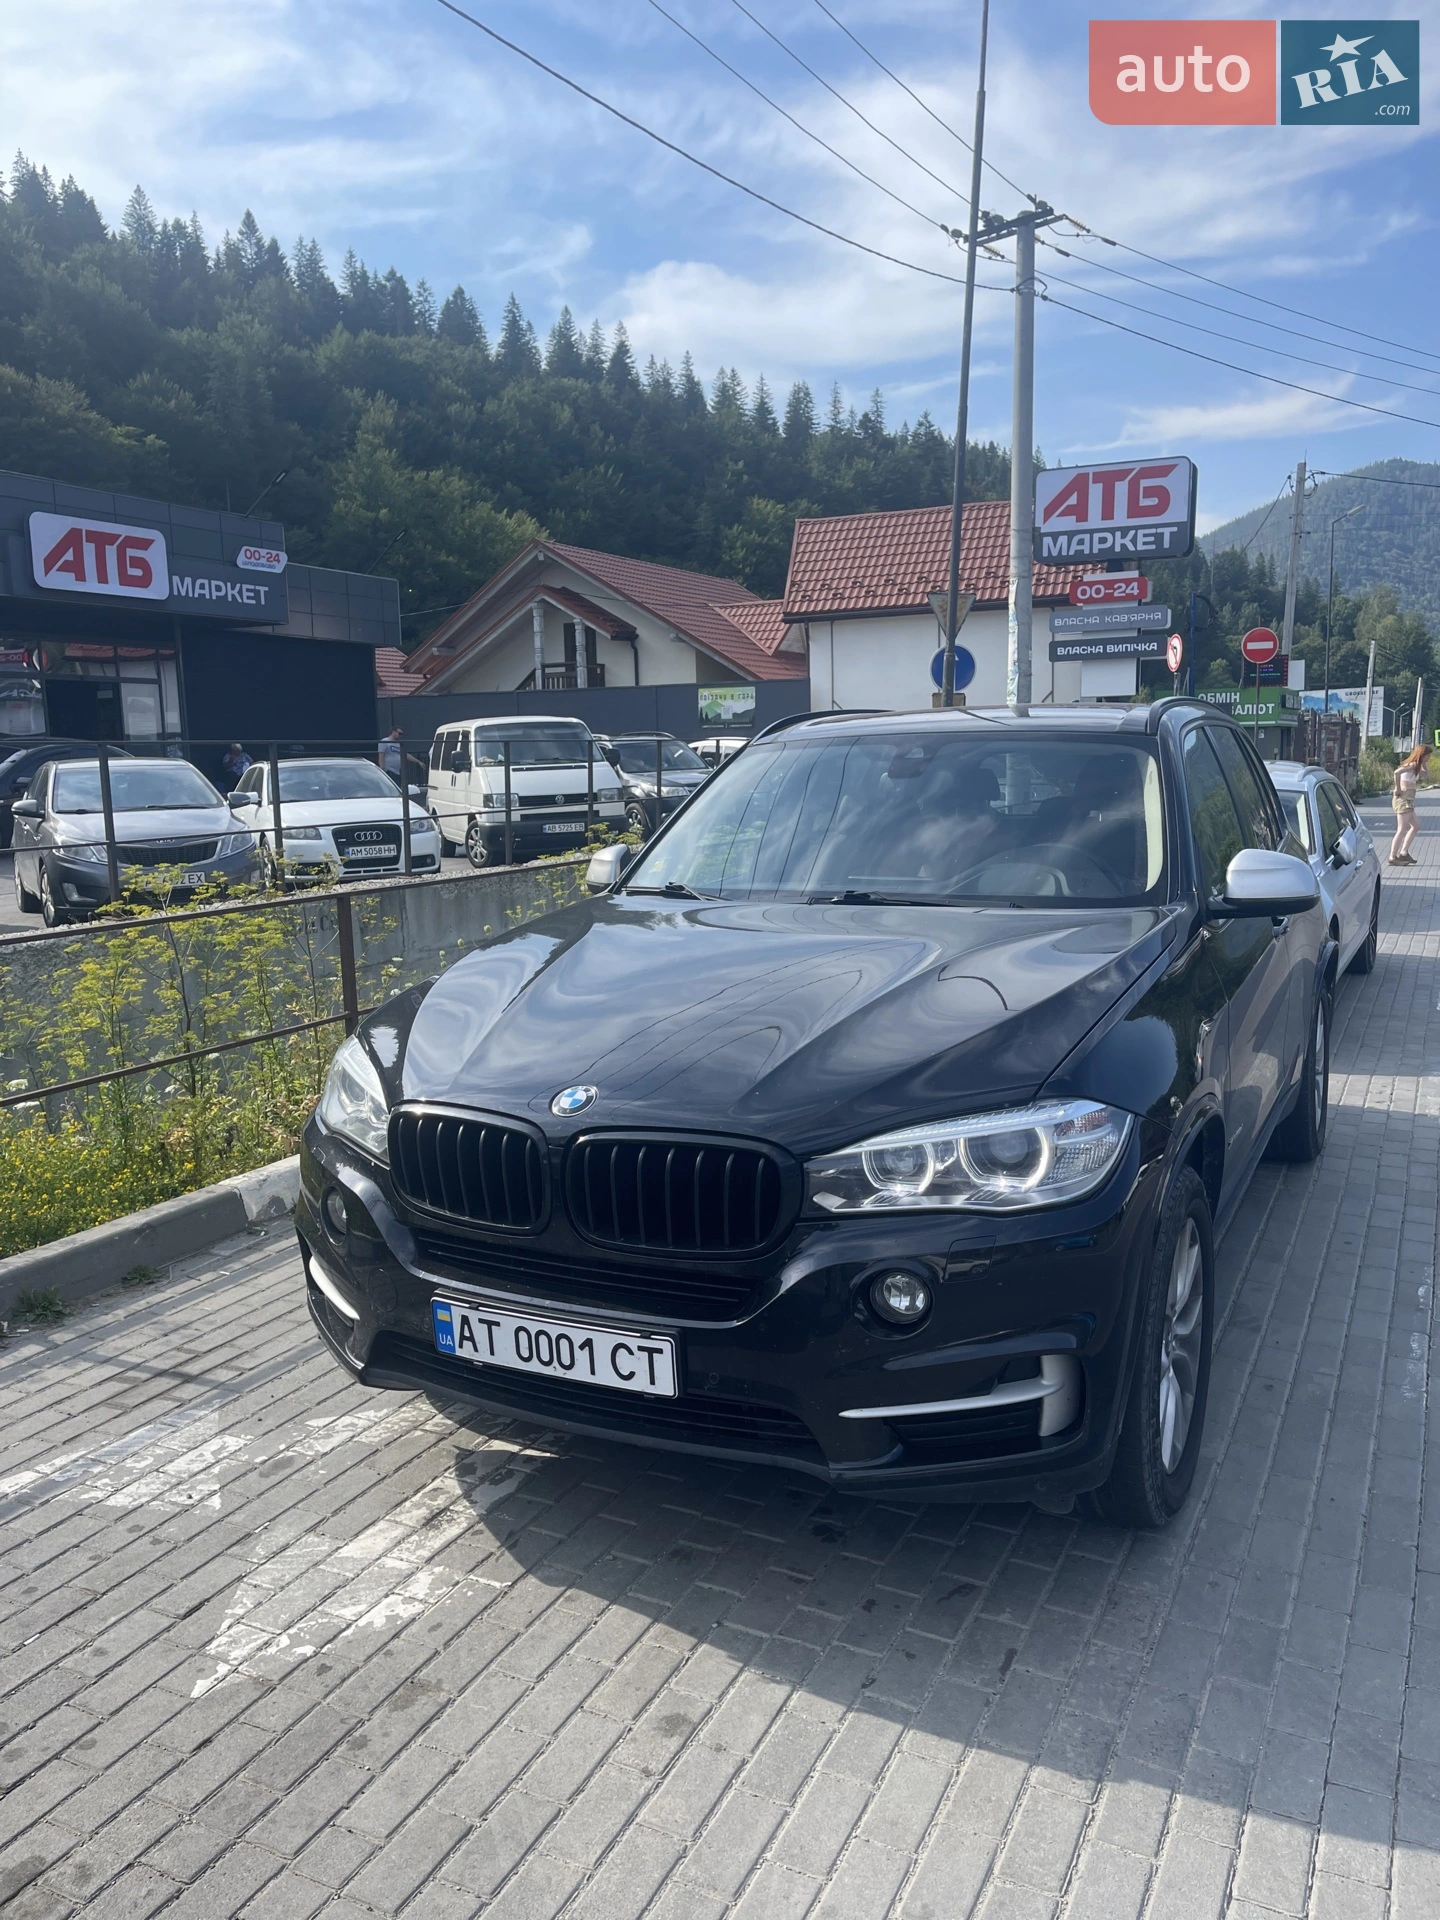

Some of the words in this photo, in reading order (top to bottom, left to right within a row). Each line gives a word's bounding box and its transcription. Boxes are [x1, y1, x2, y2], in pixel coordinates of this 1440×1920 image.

[1043, 463, 1179, 526] АТБ
[1042, 526, 1178, 557] МАРКЕТ
[244, 548, 281, 564] 00-24
[43, 527, 156, 589] АТБ
[172, 575, 269, 605] МАРКЕТ
[1077, 582, 1139, 600] 00-24
[1054, 616, 1100, 627] ВЛАСНА
[1056, 645, 1103, 656] ВЛАСНА
[1106, 642, 1158, 654] ВИПІЧКА
[1197, 692, 1240, 704] ОБМІН
[439, 1333, 454, 1347] UA
[458, 1314, 501, 1357] AT
[514, 1325, 597, 1376] 0001
[610, 1342, 664, 1386] CT
